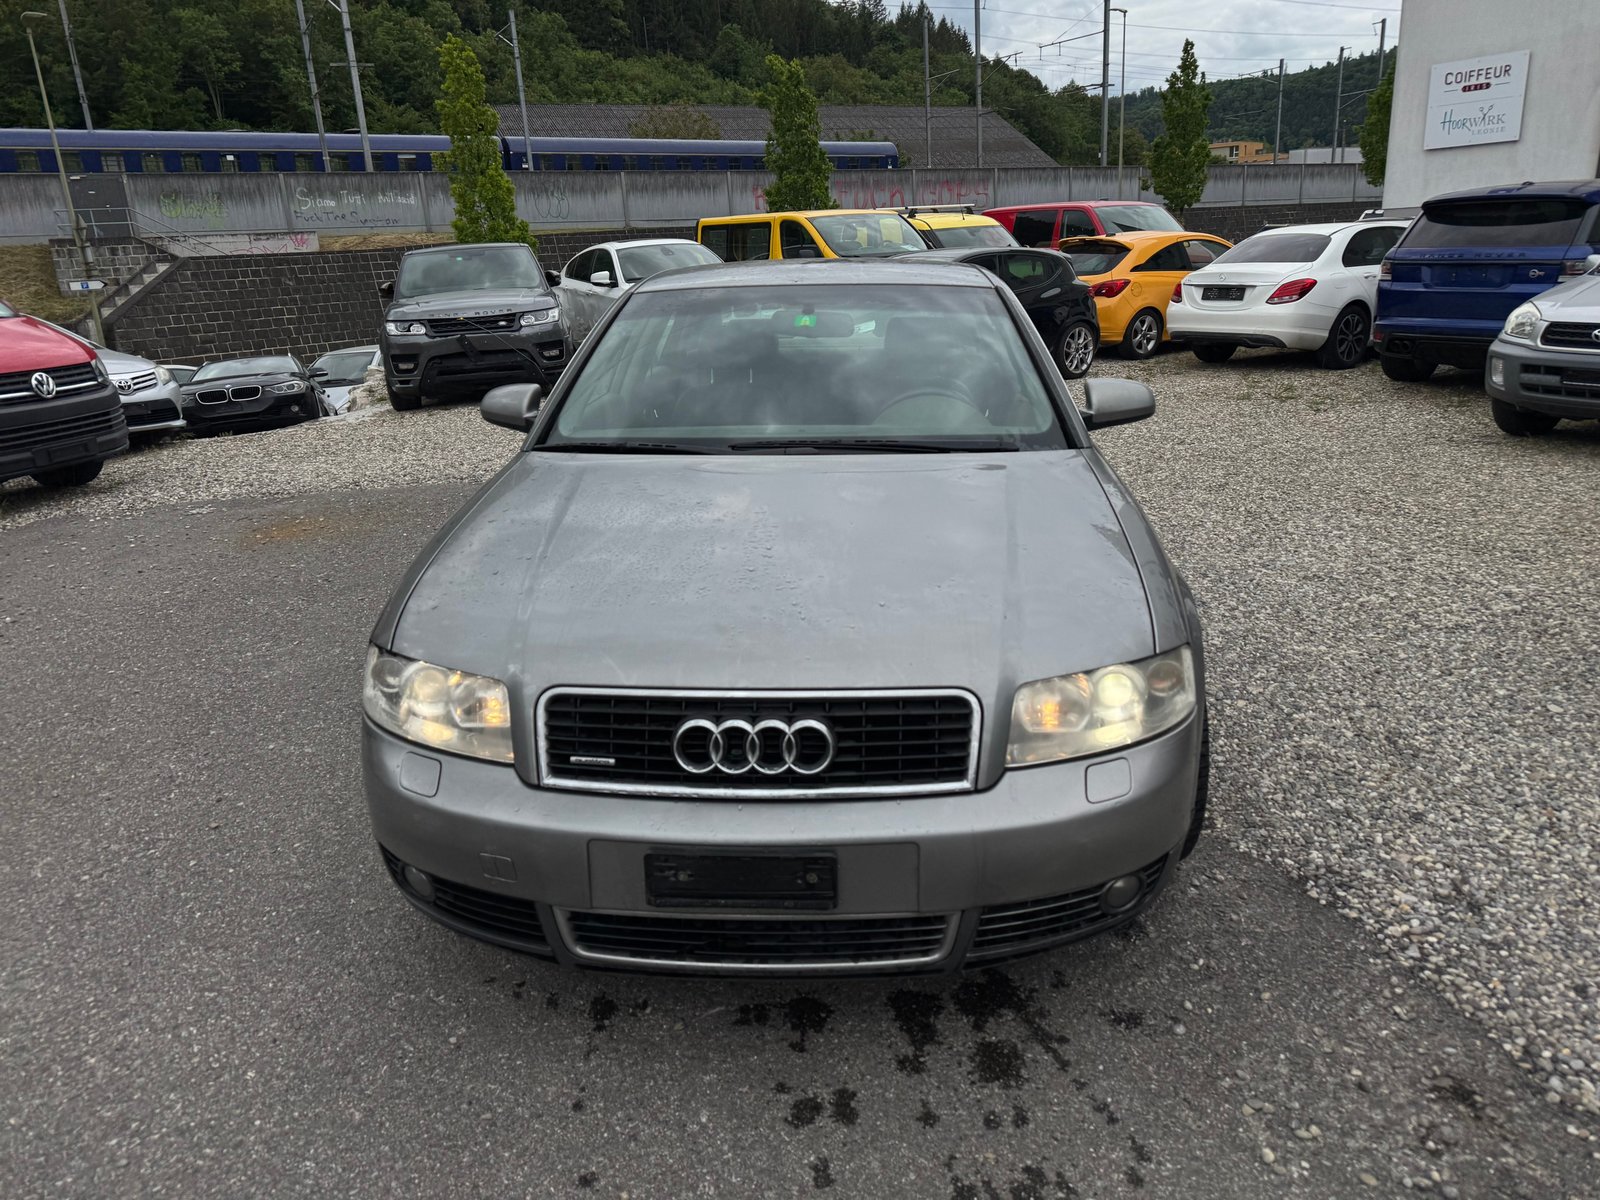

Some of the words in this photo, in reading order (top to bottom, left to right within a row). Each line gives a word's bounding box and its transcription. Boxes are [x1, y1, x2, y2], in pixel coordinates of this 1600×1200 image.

[1444, 64, 1512, 85] COIFFEUR
[1465, 83, 1488, 92] IRIS
[1471, 126, 1506, 136] LEONIE
[295, 187, 336, 210] Siamo
